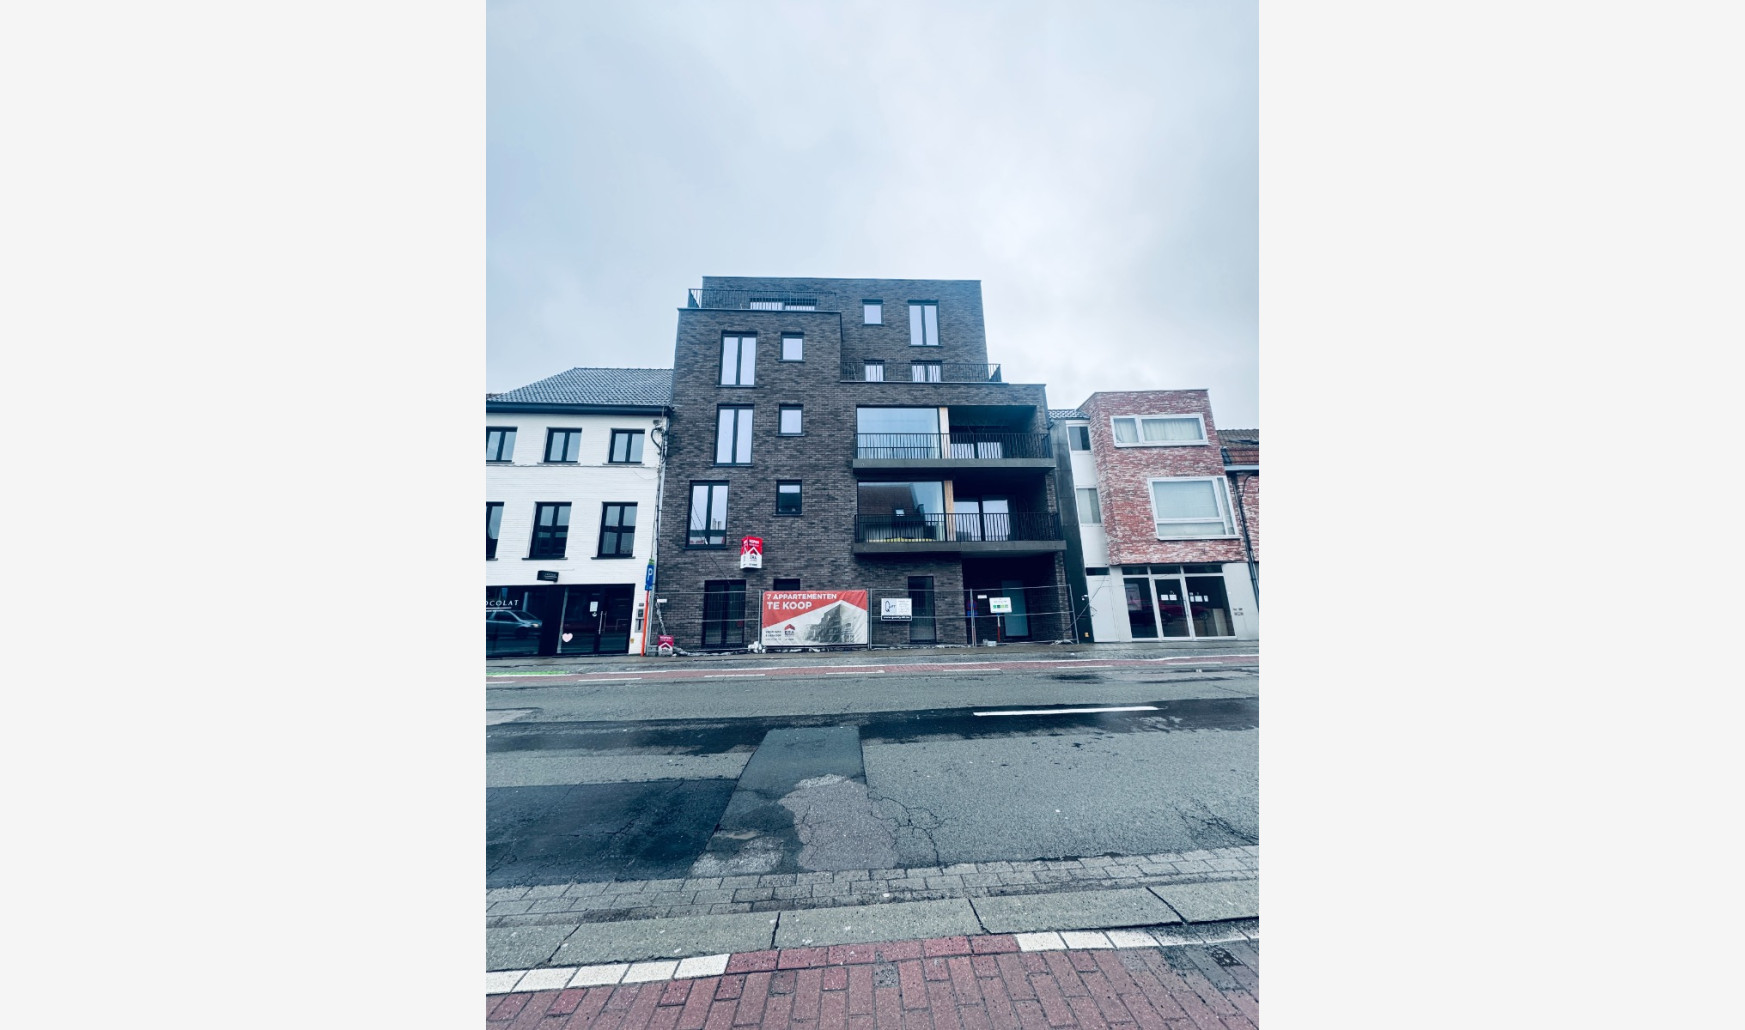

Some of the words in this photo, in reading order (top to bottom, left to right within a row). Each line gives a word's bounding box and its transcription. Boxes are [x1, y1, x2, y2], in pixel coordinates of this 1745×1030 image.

[647, 567, 653, 581] P
[767, 601, 780, 610] TE
[782, 601, 812, 610] KOOP
